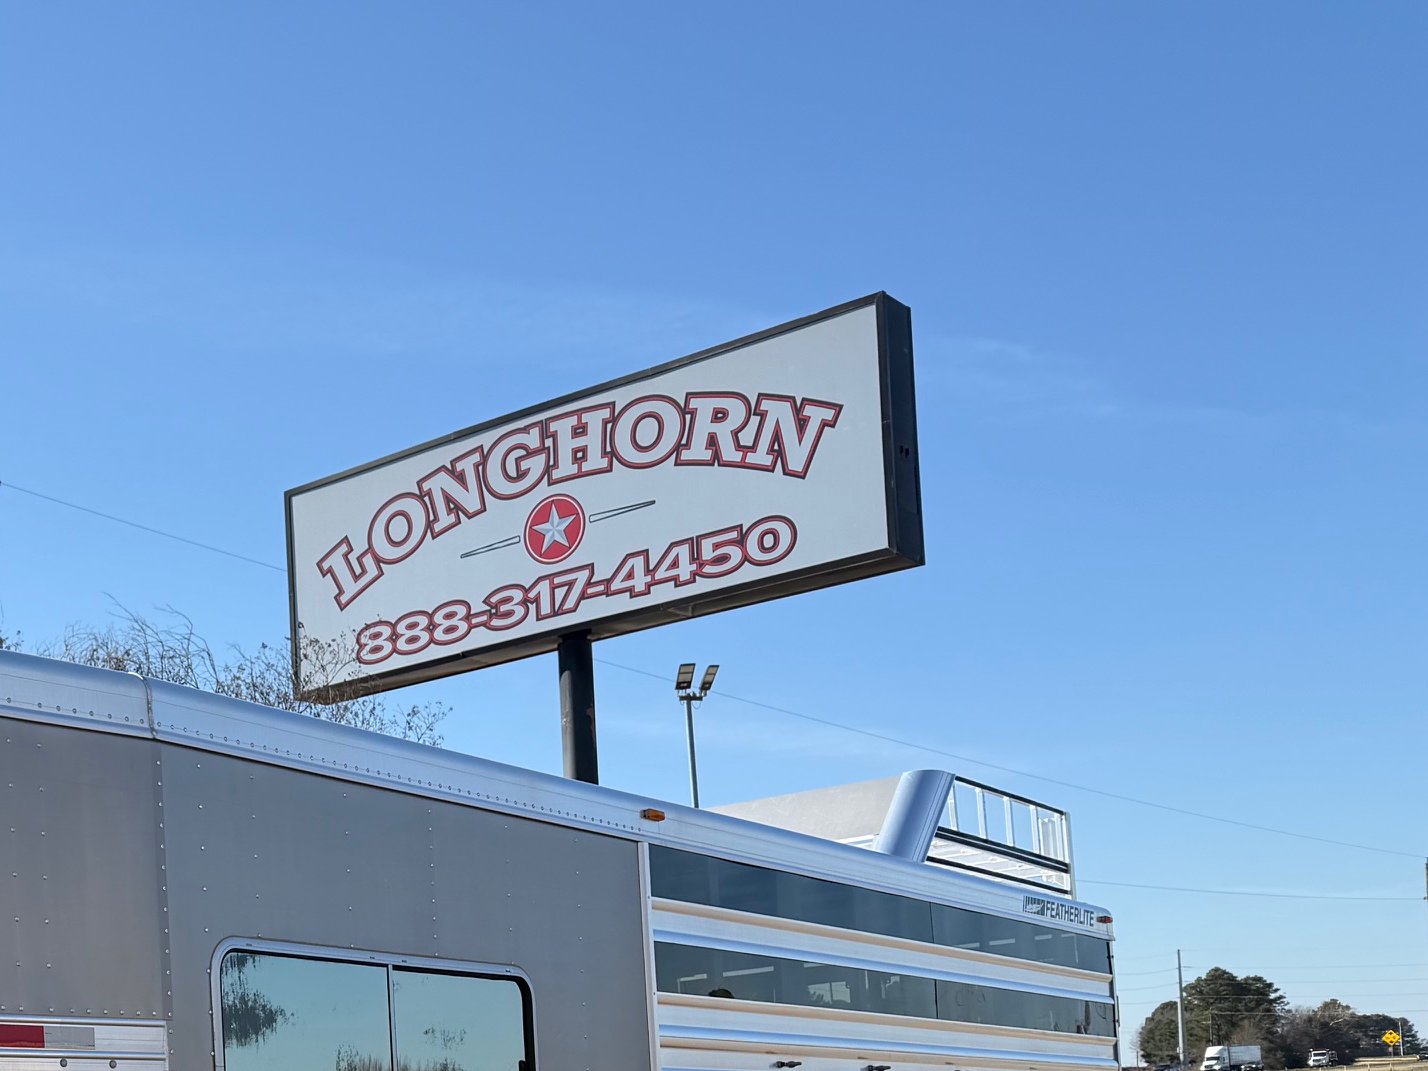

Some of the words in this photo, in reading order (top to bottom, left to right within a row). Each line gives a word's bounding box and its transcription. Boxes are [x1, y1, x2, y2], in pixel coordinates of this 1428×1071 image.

[317, 391, 843, 610] LONGHORN
[357, 515, 797, 664] 888-317-4450
[1046, 901, 1094, 926] FEATHERLITE
